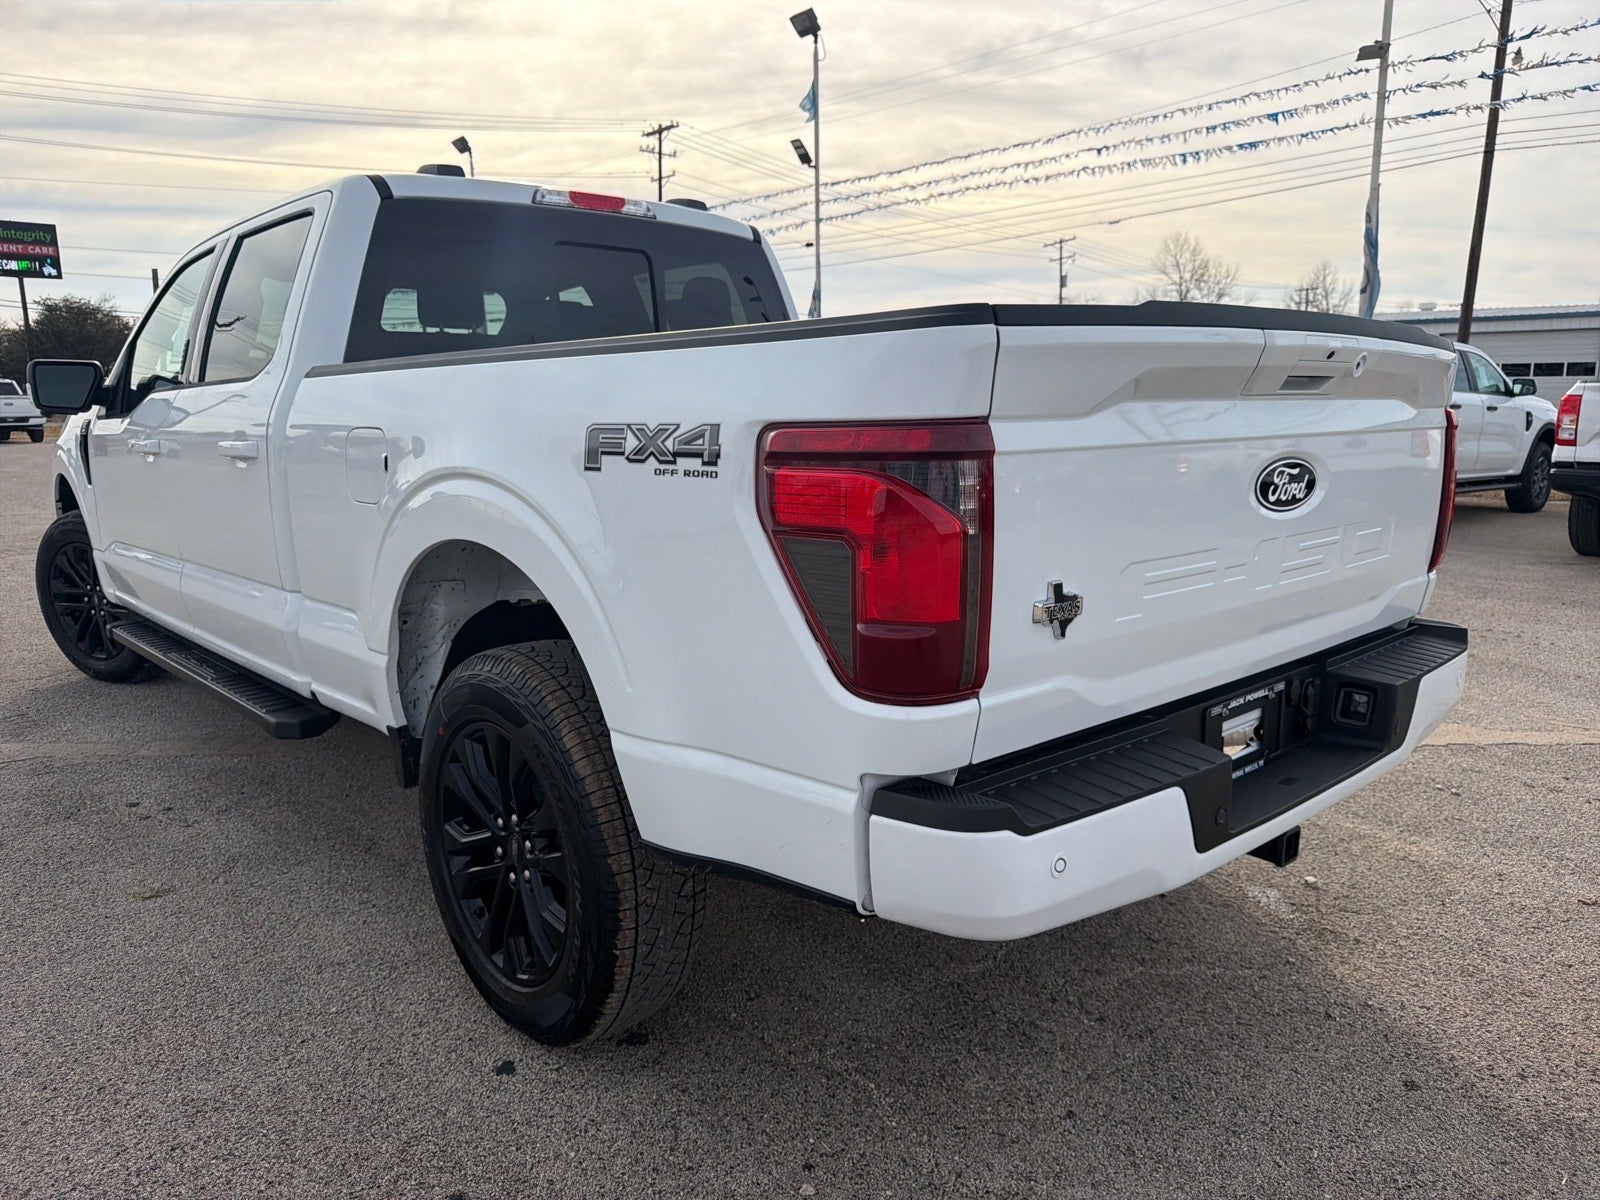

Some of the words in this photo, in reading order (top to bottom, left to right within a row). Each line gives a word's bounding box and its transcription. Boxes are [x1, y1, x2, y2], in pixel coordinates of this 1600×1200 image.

[27, 245, 54, 255] CARE
[584, 423, 721, 471] FX4
[654, 468, 679, 477] OFF
[683, 469, 719, 479] ROAD
[1268, 467, 1309, 503] Ford
[1112, 516, 1395, 623] F-150
[1045, 599, 1081, 620] TEXAS
[1227, 696, 1245, 709] JACK
[1245, 688, 1269, 703] POWELL
